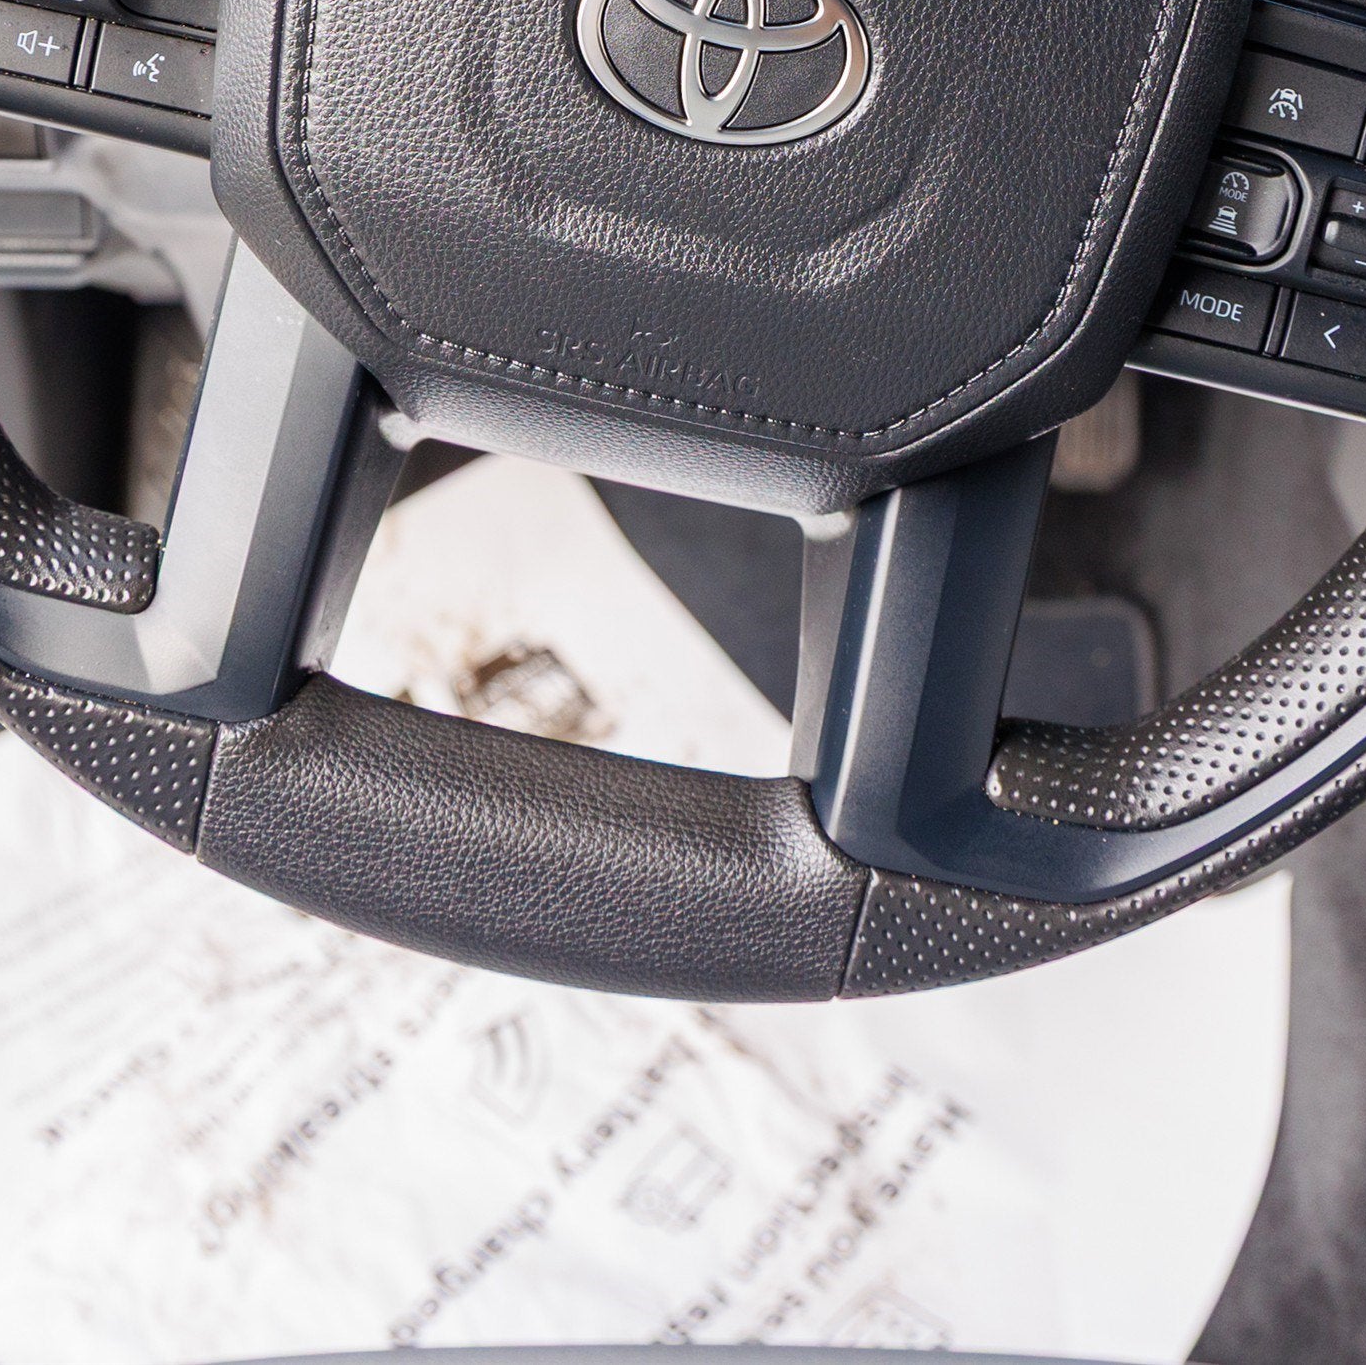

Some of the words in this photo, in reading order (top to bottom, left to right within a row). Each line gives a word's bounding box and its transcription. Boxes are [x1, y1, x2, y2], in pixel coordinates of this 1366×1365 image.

[1218, 186, 1249, 203] MODE
[1179, 289, 1244, 323] MODE
[540, 329, 606, 366] SRS
[613, 349, 762, 398] AIRBAG
